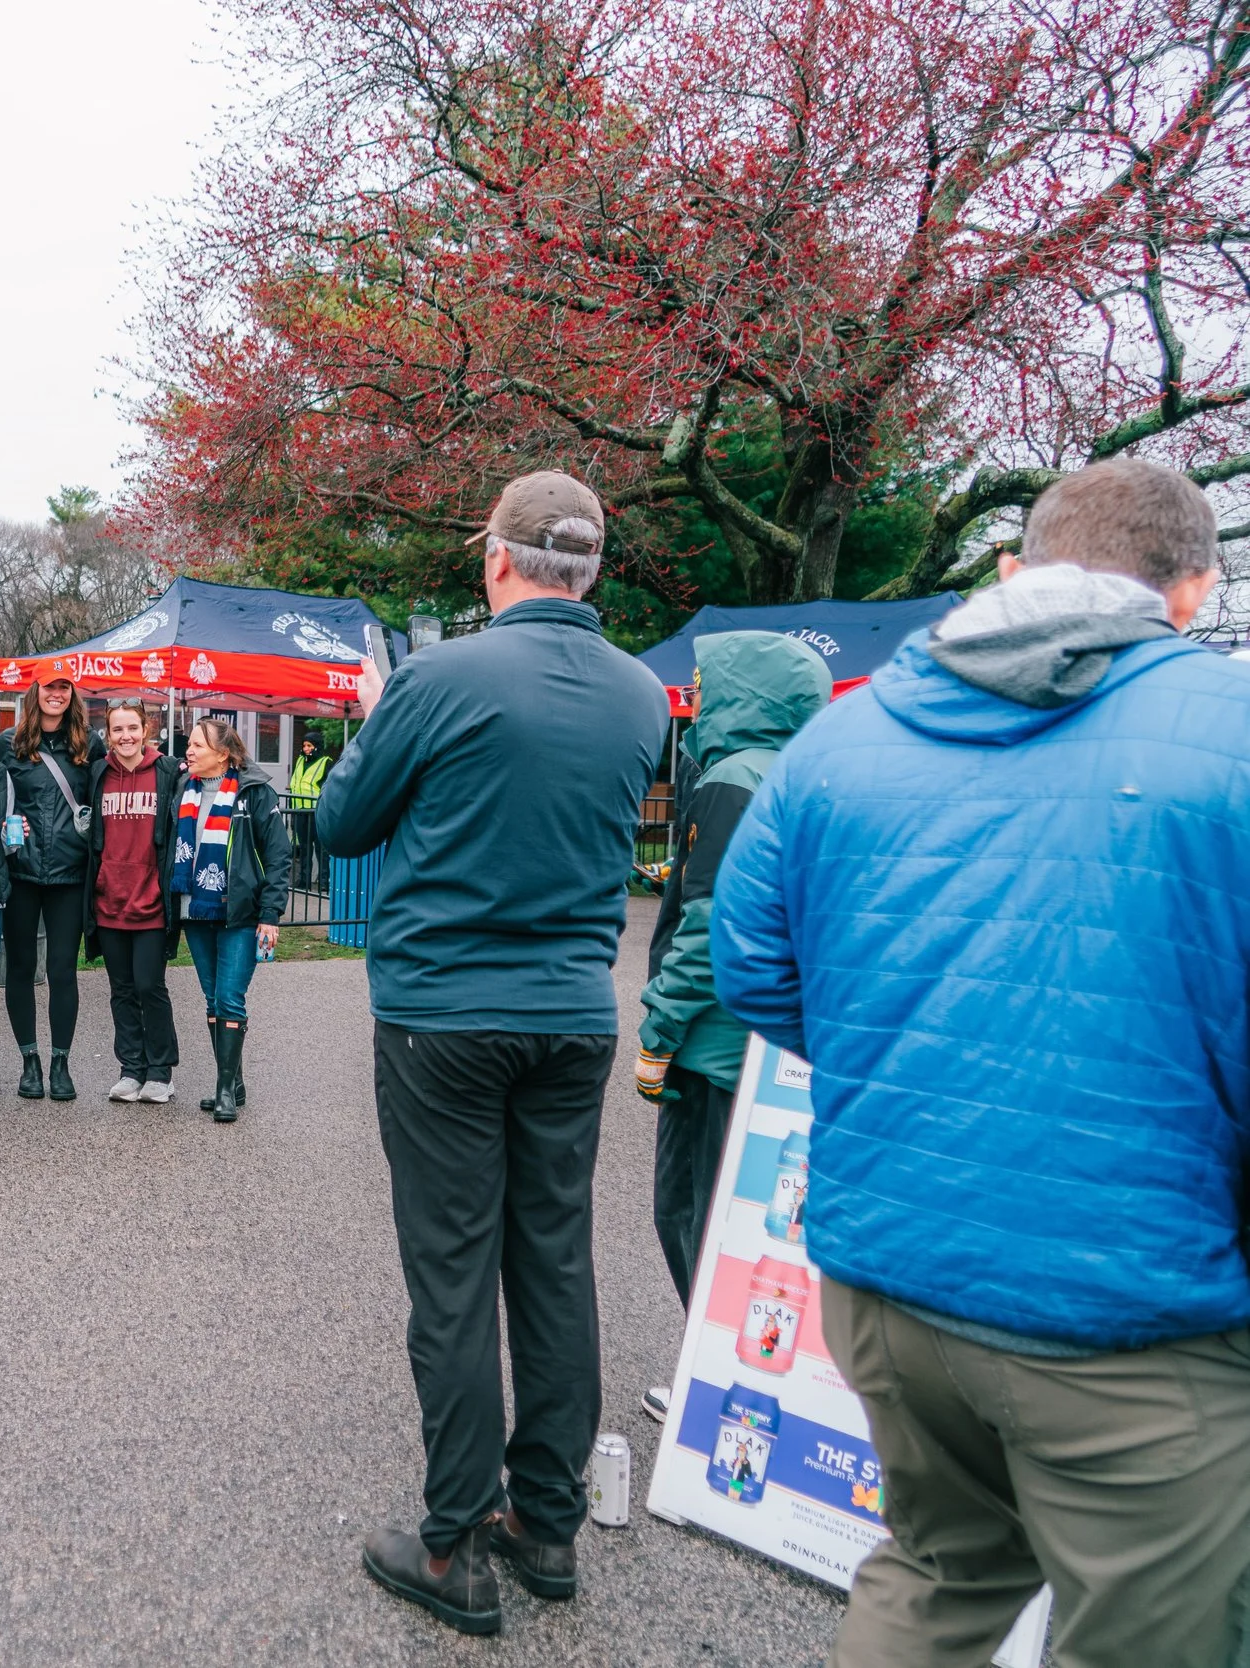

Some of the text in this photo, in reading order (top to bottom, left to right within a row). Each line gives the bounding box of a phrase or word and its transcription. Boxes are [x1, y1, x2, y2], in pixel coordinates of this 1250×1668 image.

[751, 1275, 783, 1288] CHATHAM
[753, 1304, 795, 1326] DLAK
[730, 1403, 745, 1414] THE
[723, 1431, 766, 1457] DLAK
[804, 1456, 846, 1480] Premium
[816, 1442, 857, 1474] THE
[791, 1500, 826, 1521] PREMIUM
[827, 1515, 851, 1531] LIGHT
[853, 1526, 859, 1535] &
[854, 1536, 874, 1550] GING
[782, 1538, 853, 1578] DRINKDLAK.
